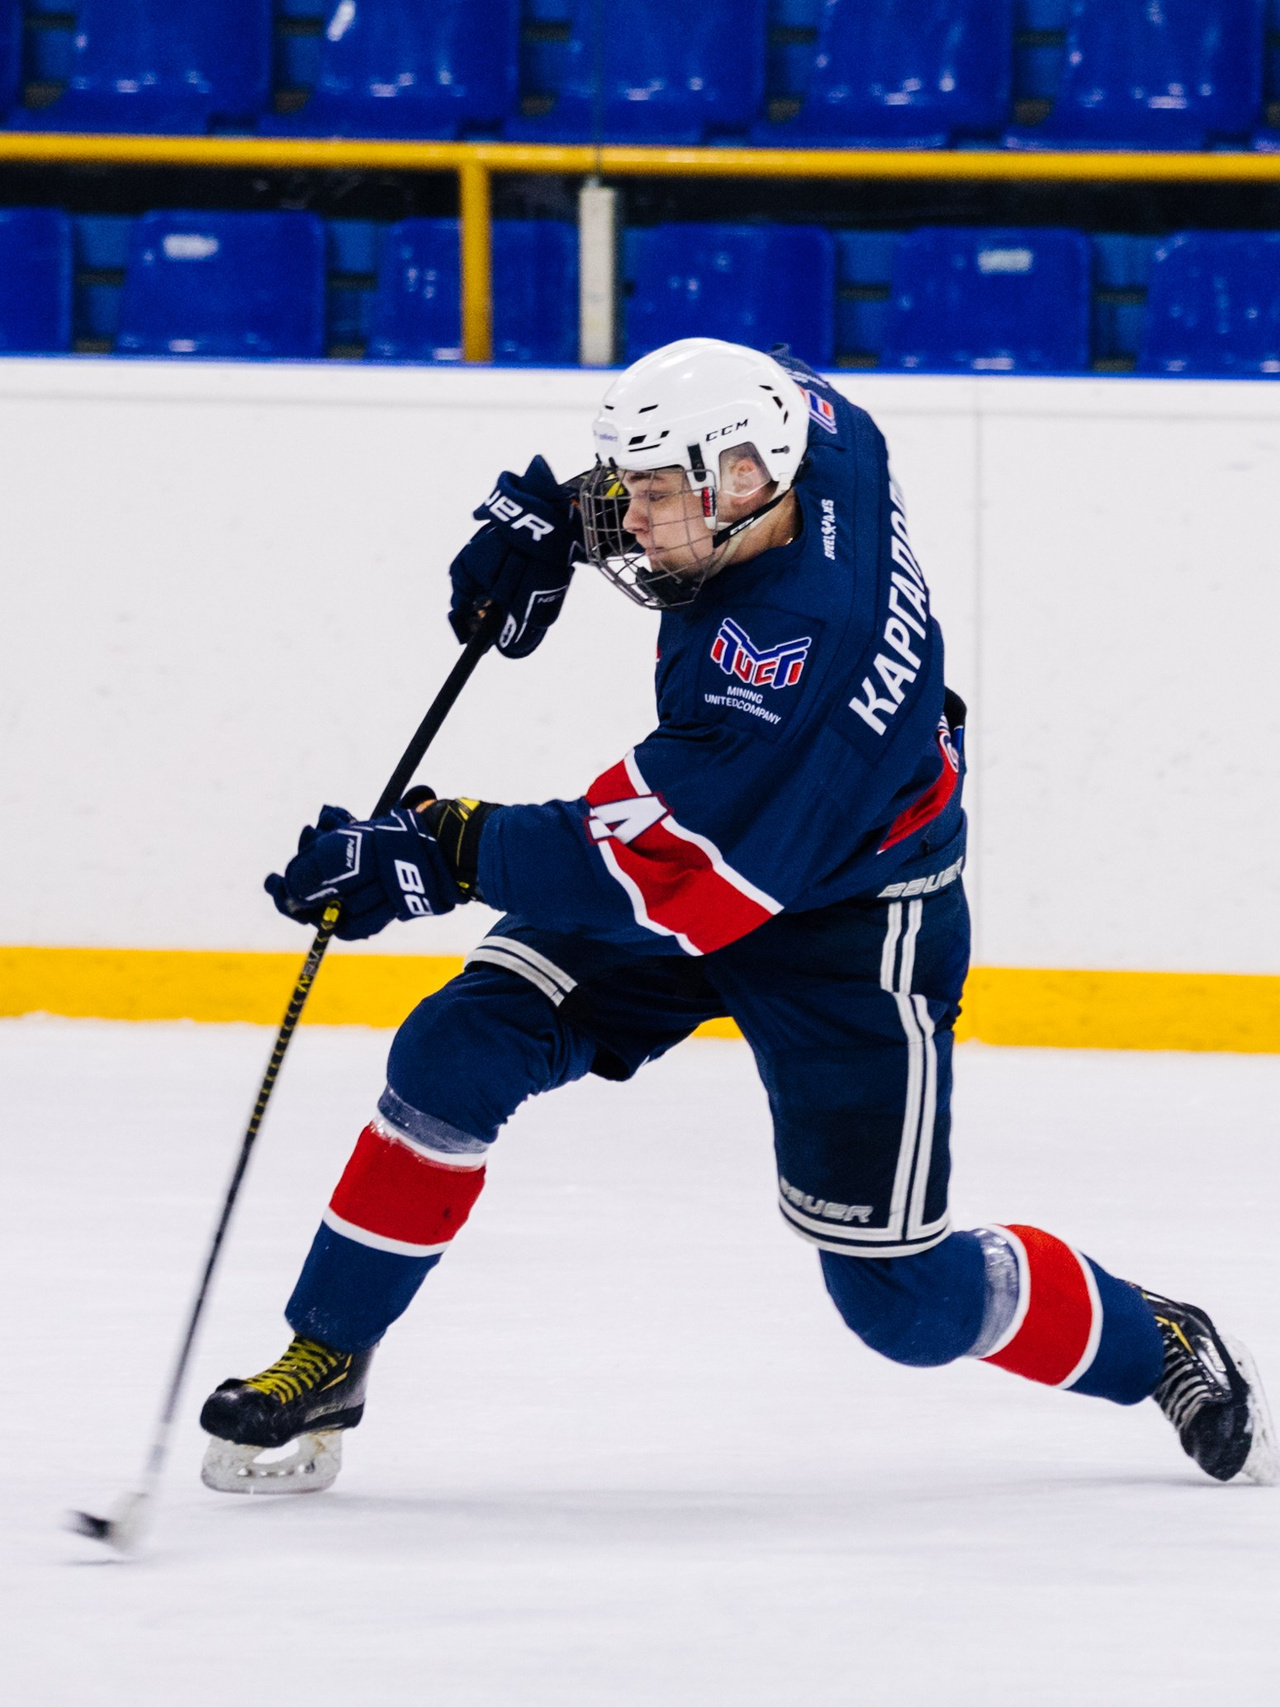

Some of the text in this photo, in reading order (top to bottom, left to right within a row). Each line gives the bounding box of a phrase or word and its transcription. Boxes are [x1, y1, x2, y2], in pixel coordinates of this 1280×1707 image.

[705, 418, 749, 442] CCM
[726, 685, 764, 705] MINING
[704, 693, 782, 725] UNITEDCOMPANY
